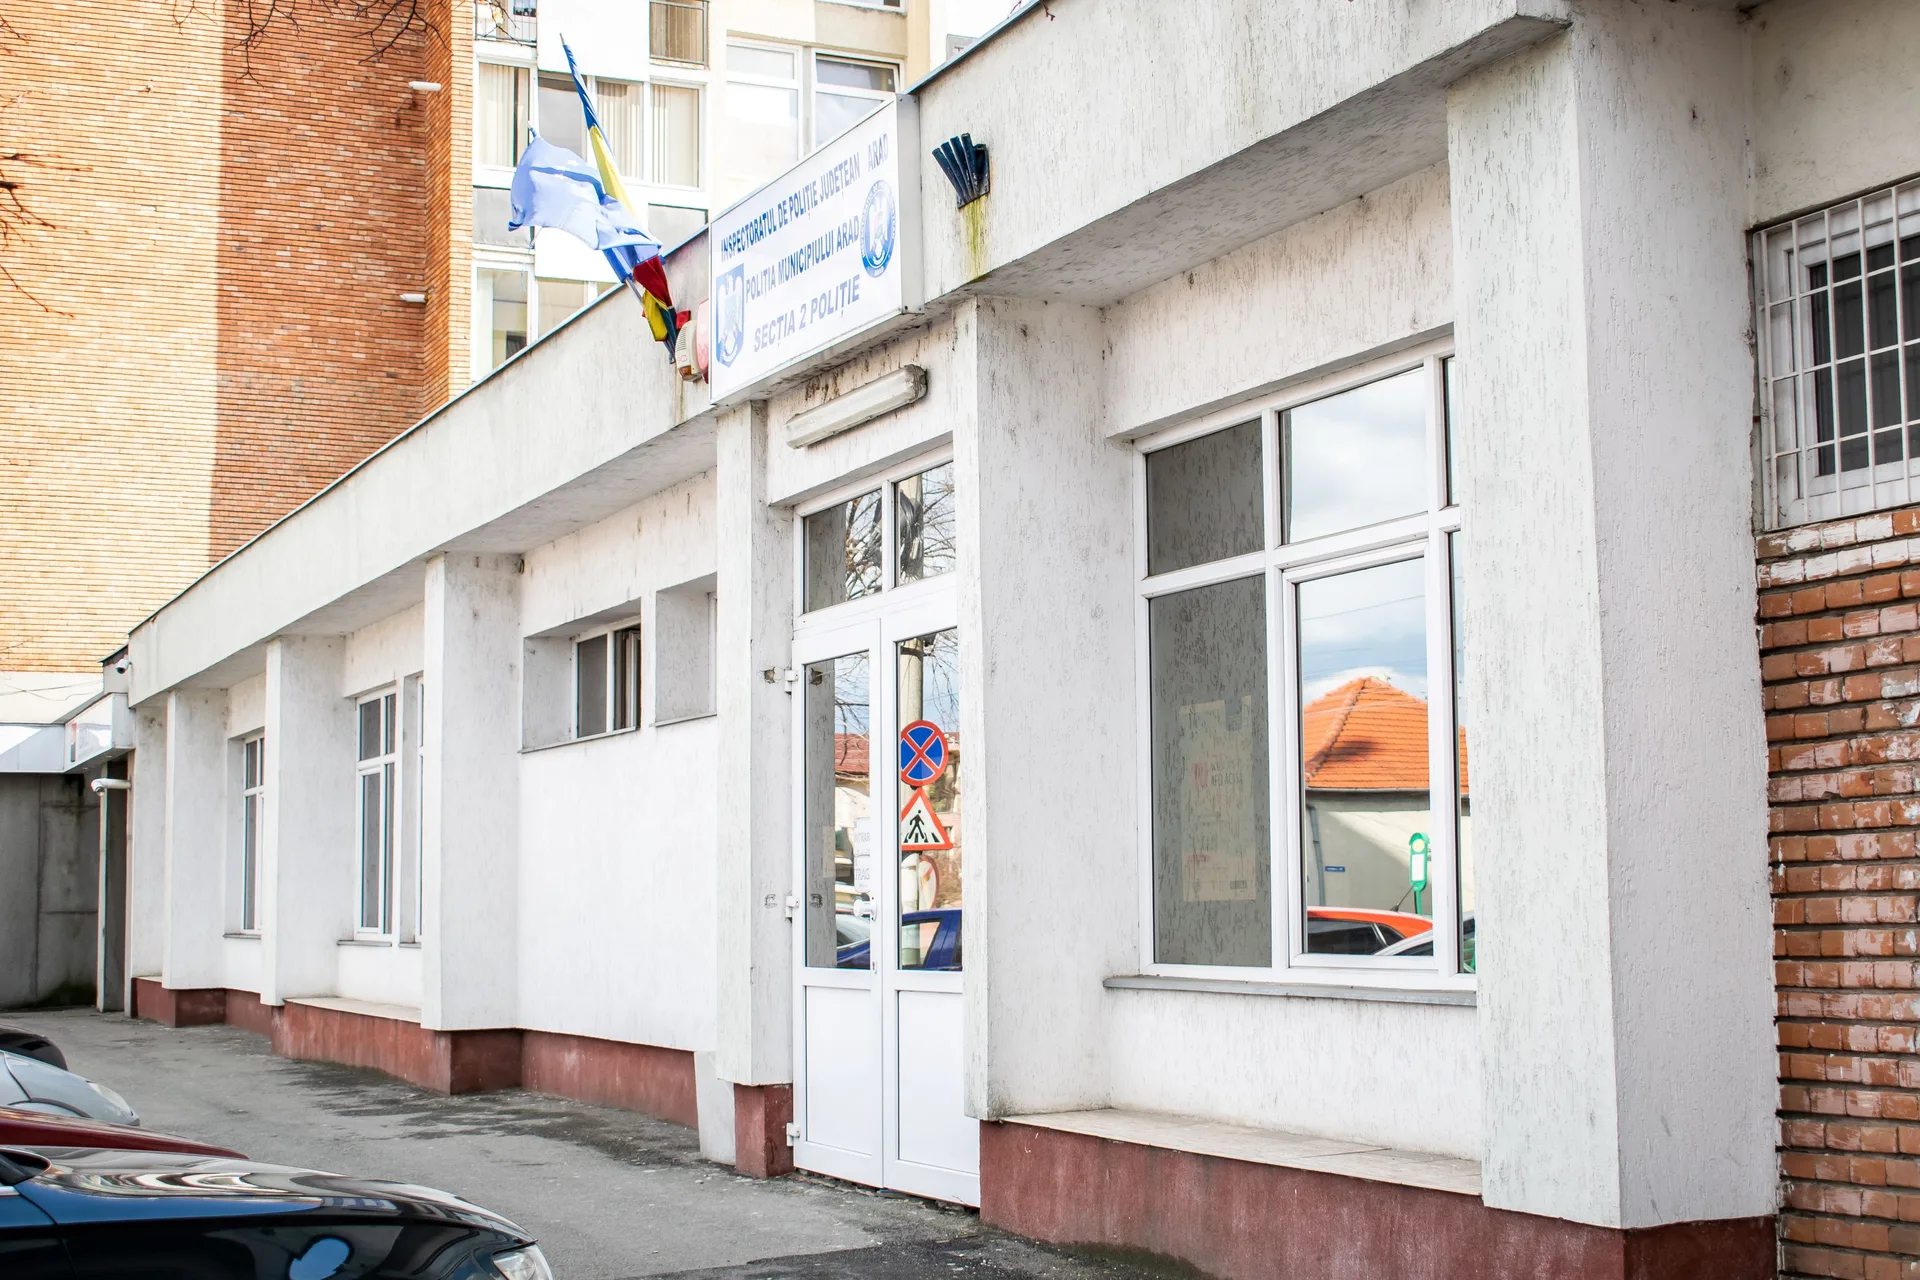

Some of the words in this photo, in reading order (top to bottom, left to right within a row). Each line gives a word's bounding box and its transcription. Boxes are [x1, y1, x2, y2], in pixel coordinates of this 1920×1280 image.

[721, 208, 777, 263] INSPECTORATUL
[778, 200, 788, 229] DE
[868, 133, 889, 172] ARAD
[778, 230, 834, 286] MUNICIPIULUI
[836, 215, 859, 252] ARAD
[799, 303, 807, 330] 2
